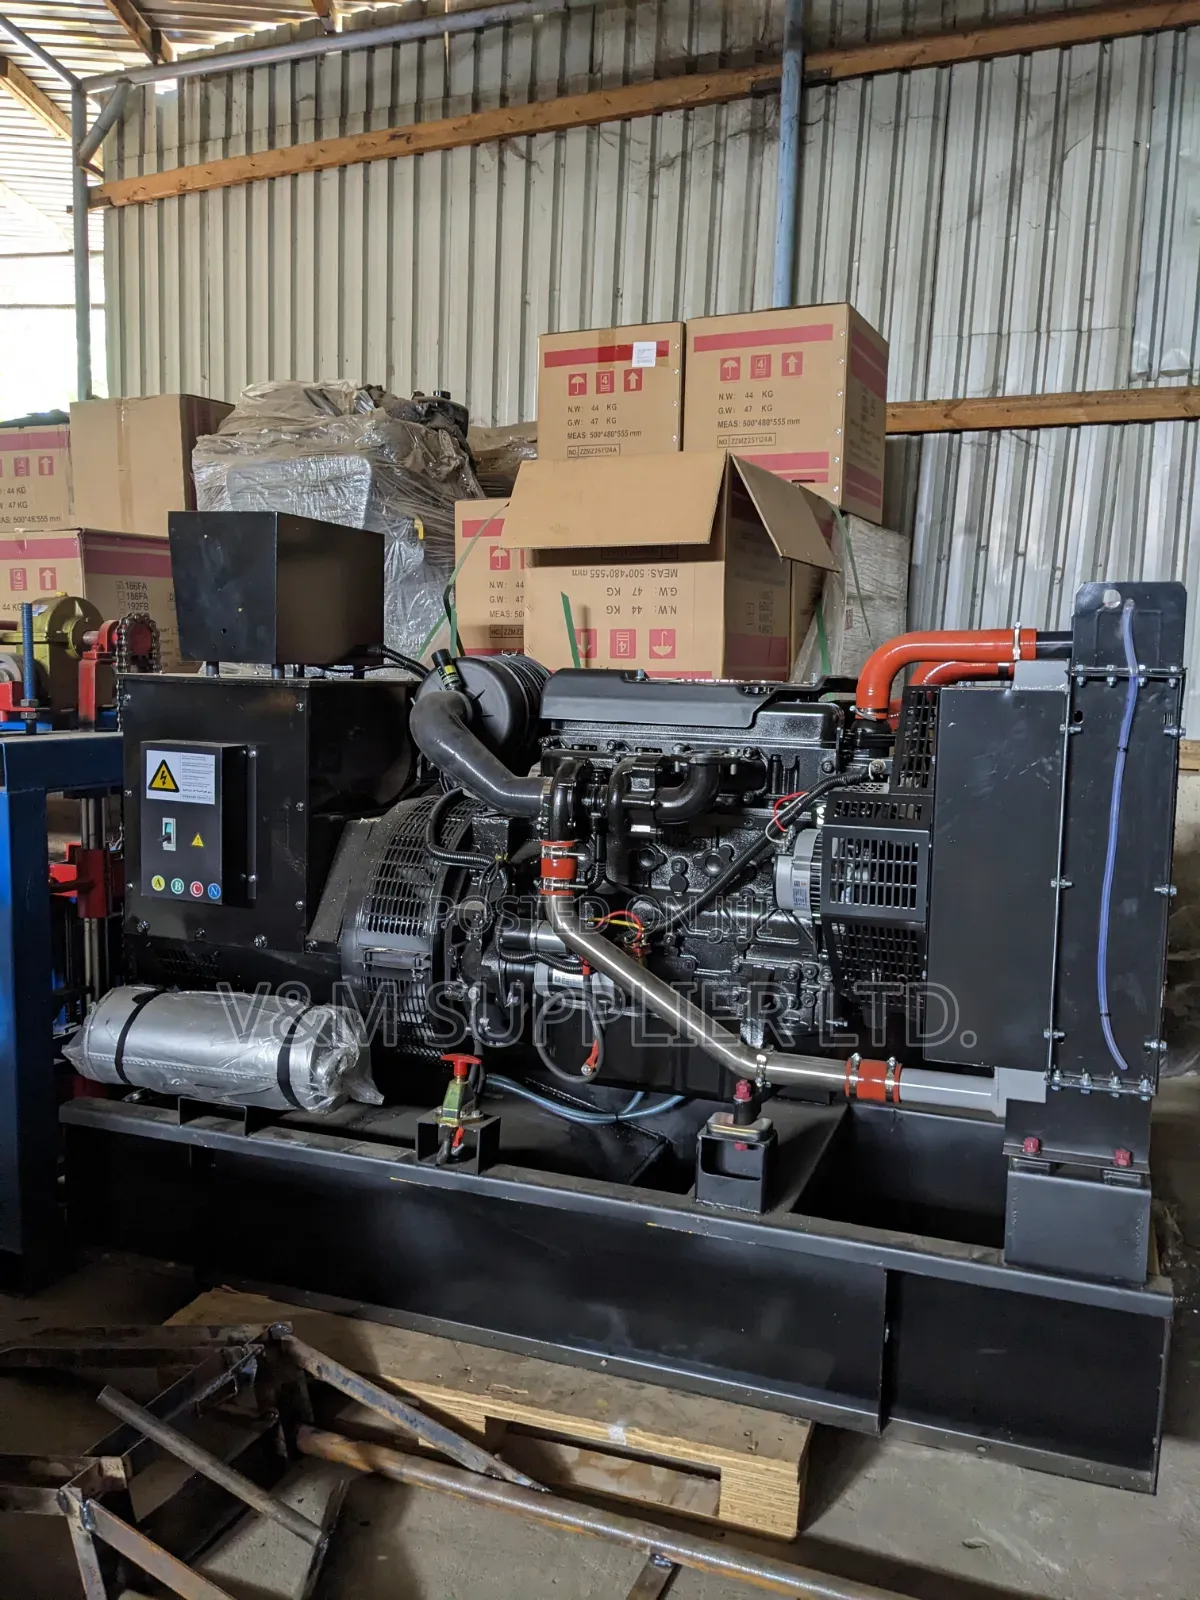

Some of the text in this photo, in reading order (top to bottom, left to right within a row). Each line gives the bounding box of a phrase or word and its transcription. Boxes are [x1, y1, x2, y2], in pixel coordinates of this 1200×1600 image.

[758, 360, 764, 368] 4
[602, 376, 608, 384] 4
[762, 390, 774, 398] KG
[761, 404, 773, 412] KG
[717, 420, 741, 429] MEAS:
[16, 486, 26, 494] KG
[648, 568, 678, 578] MEAS:
[125, 582, 147, 591] 186FA
[606, 587, 621, 596] KG
[632, 587, 643, 596] 47
[126, 592, 148, 600] 188FA
[12, 603, 22, 611] KG
[606, 605, 620, 614] KG
[632, 605, 642, 614] 44
[490, 610, 512, 618] MEAS:
[619, 641, 626, 653] 4
